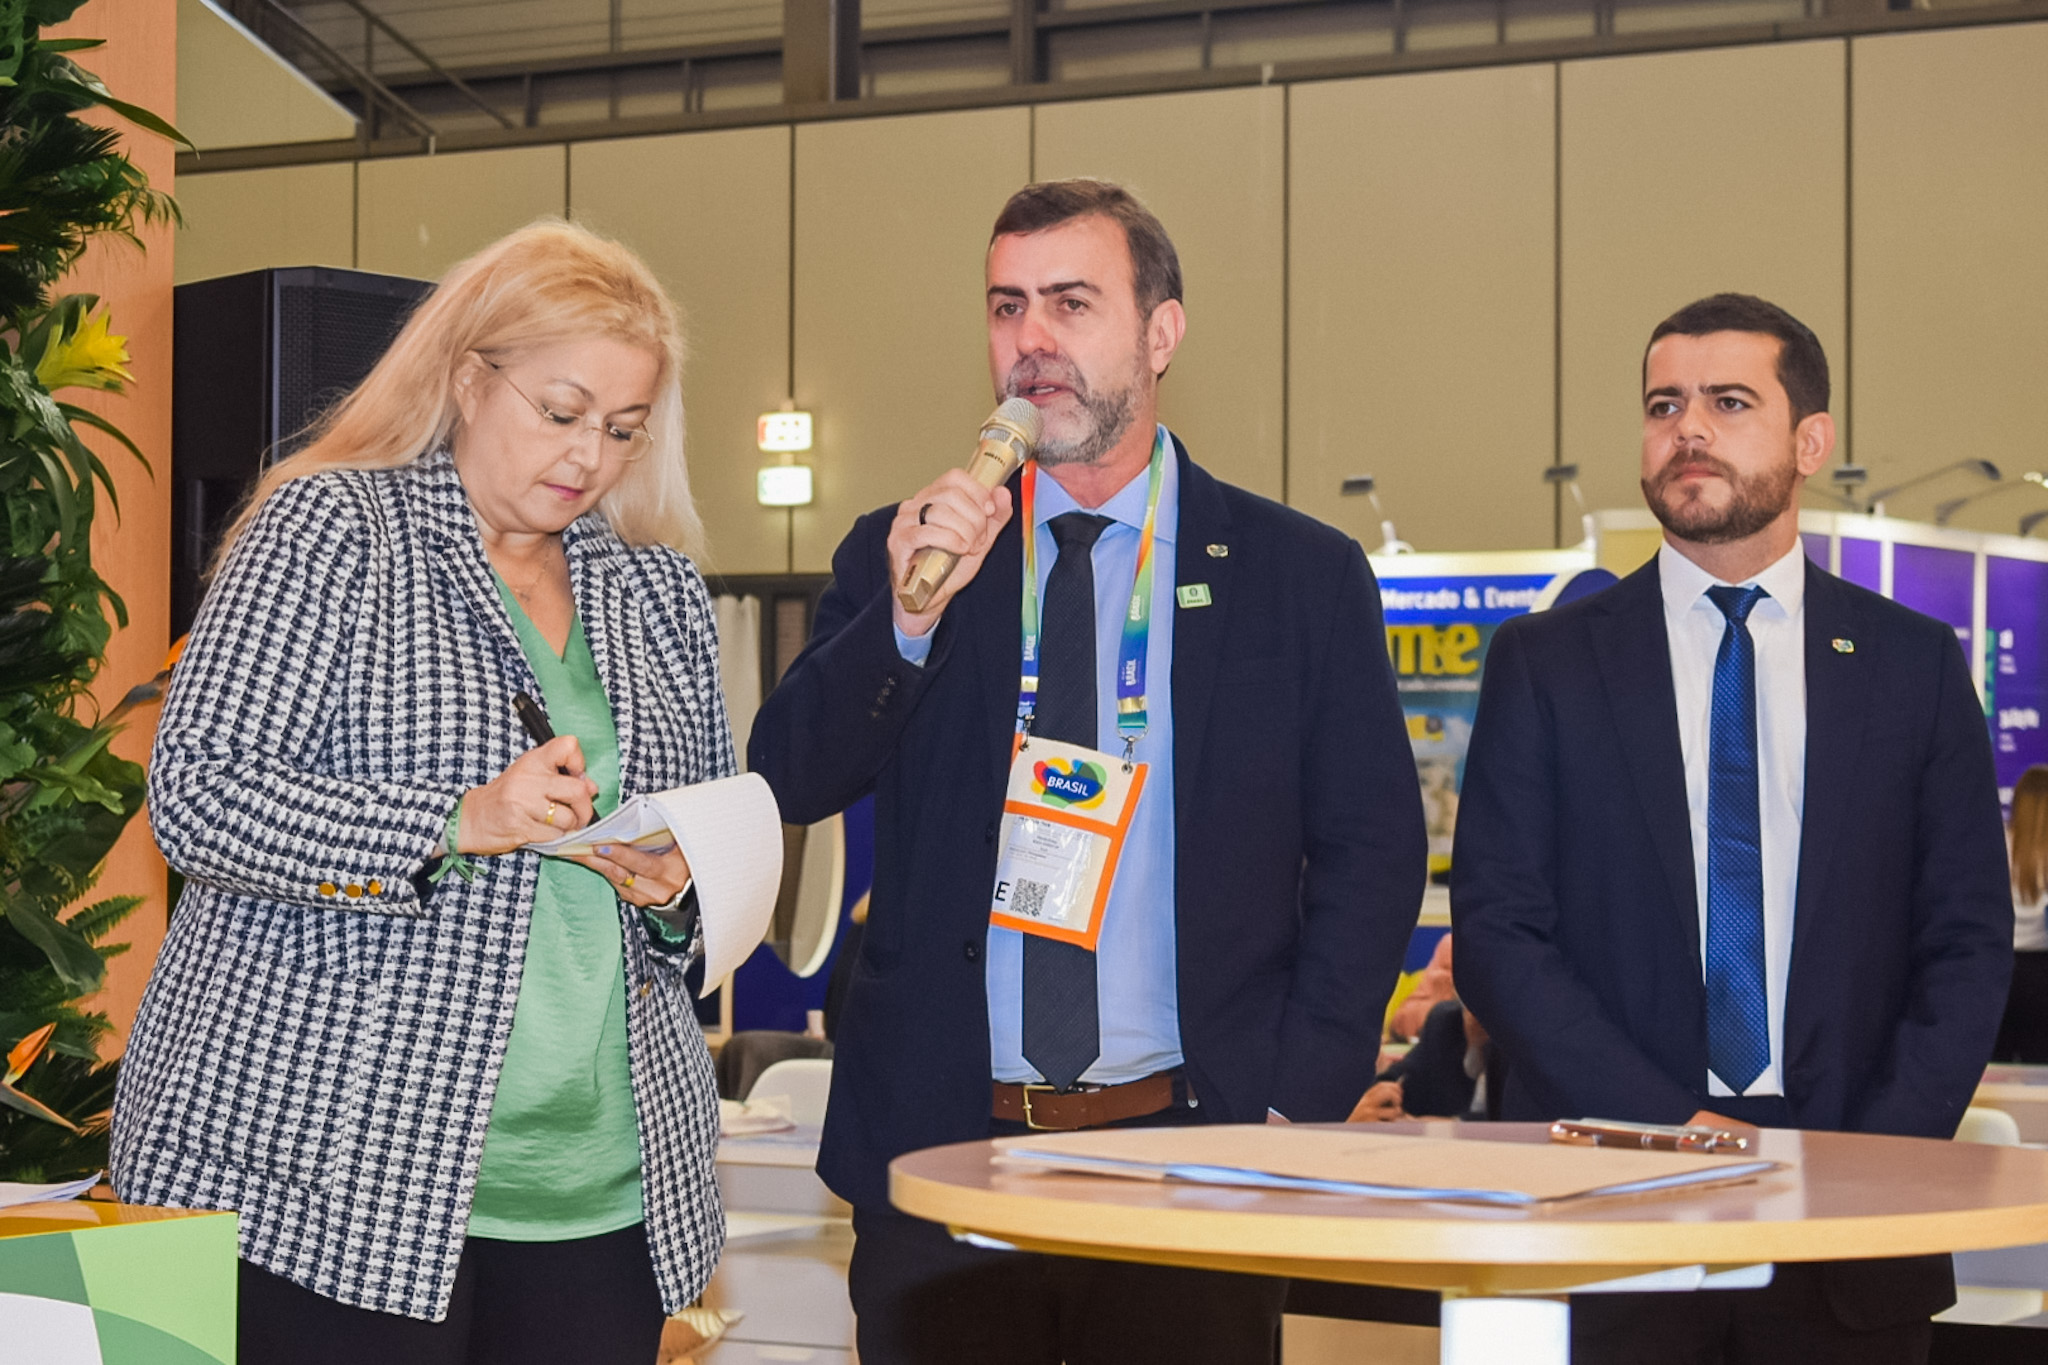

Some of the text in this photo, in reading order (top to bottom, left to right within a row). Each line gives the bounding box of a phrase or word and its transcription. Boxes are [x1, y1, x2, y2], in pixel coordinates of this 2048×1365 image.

[1463, 586, 1481, 608] &
[1047, 775, 1089, 797] BRASIL
[994, 880, 1010, 902] E
